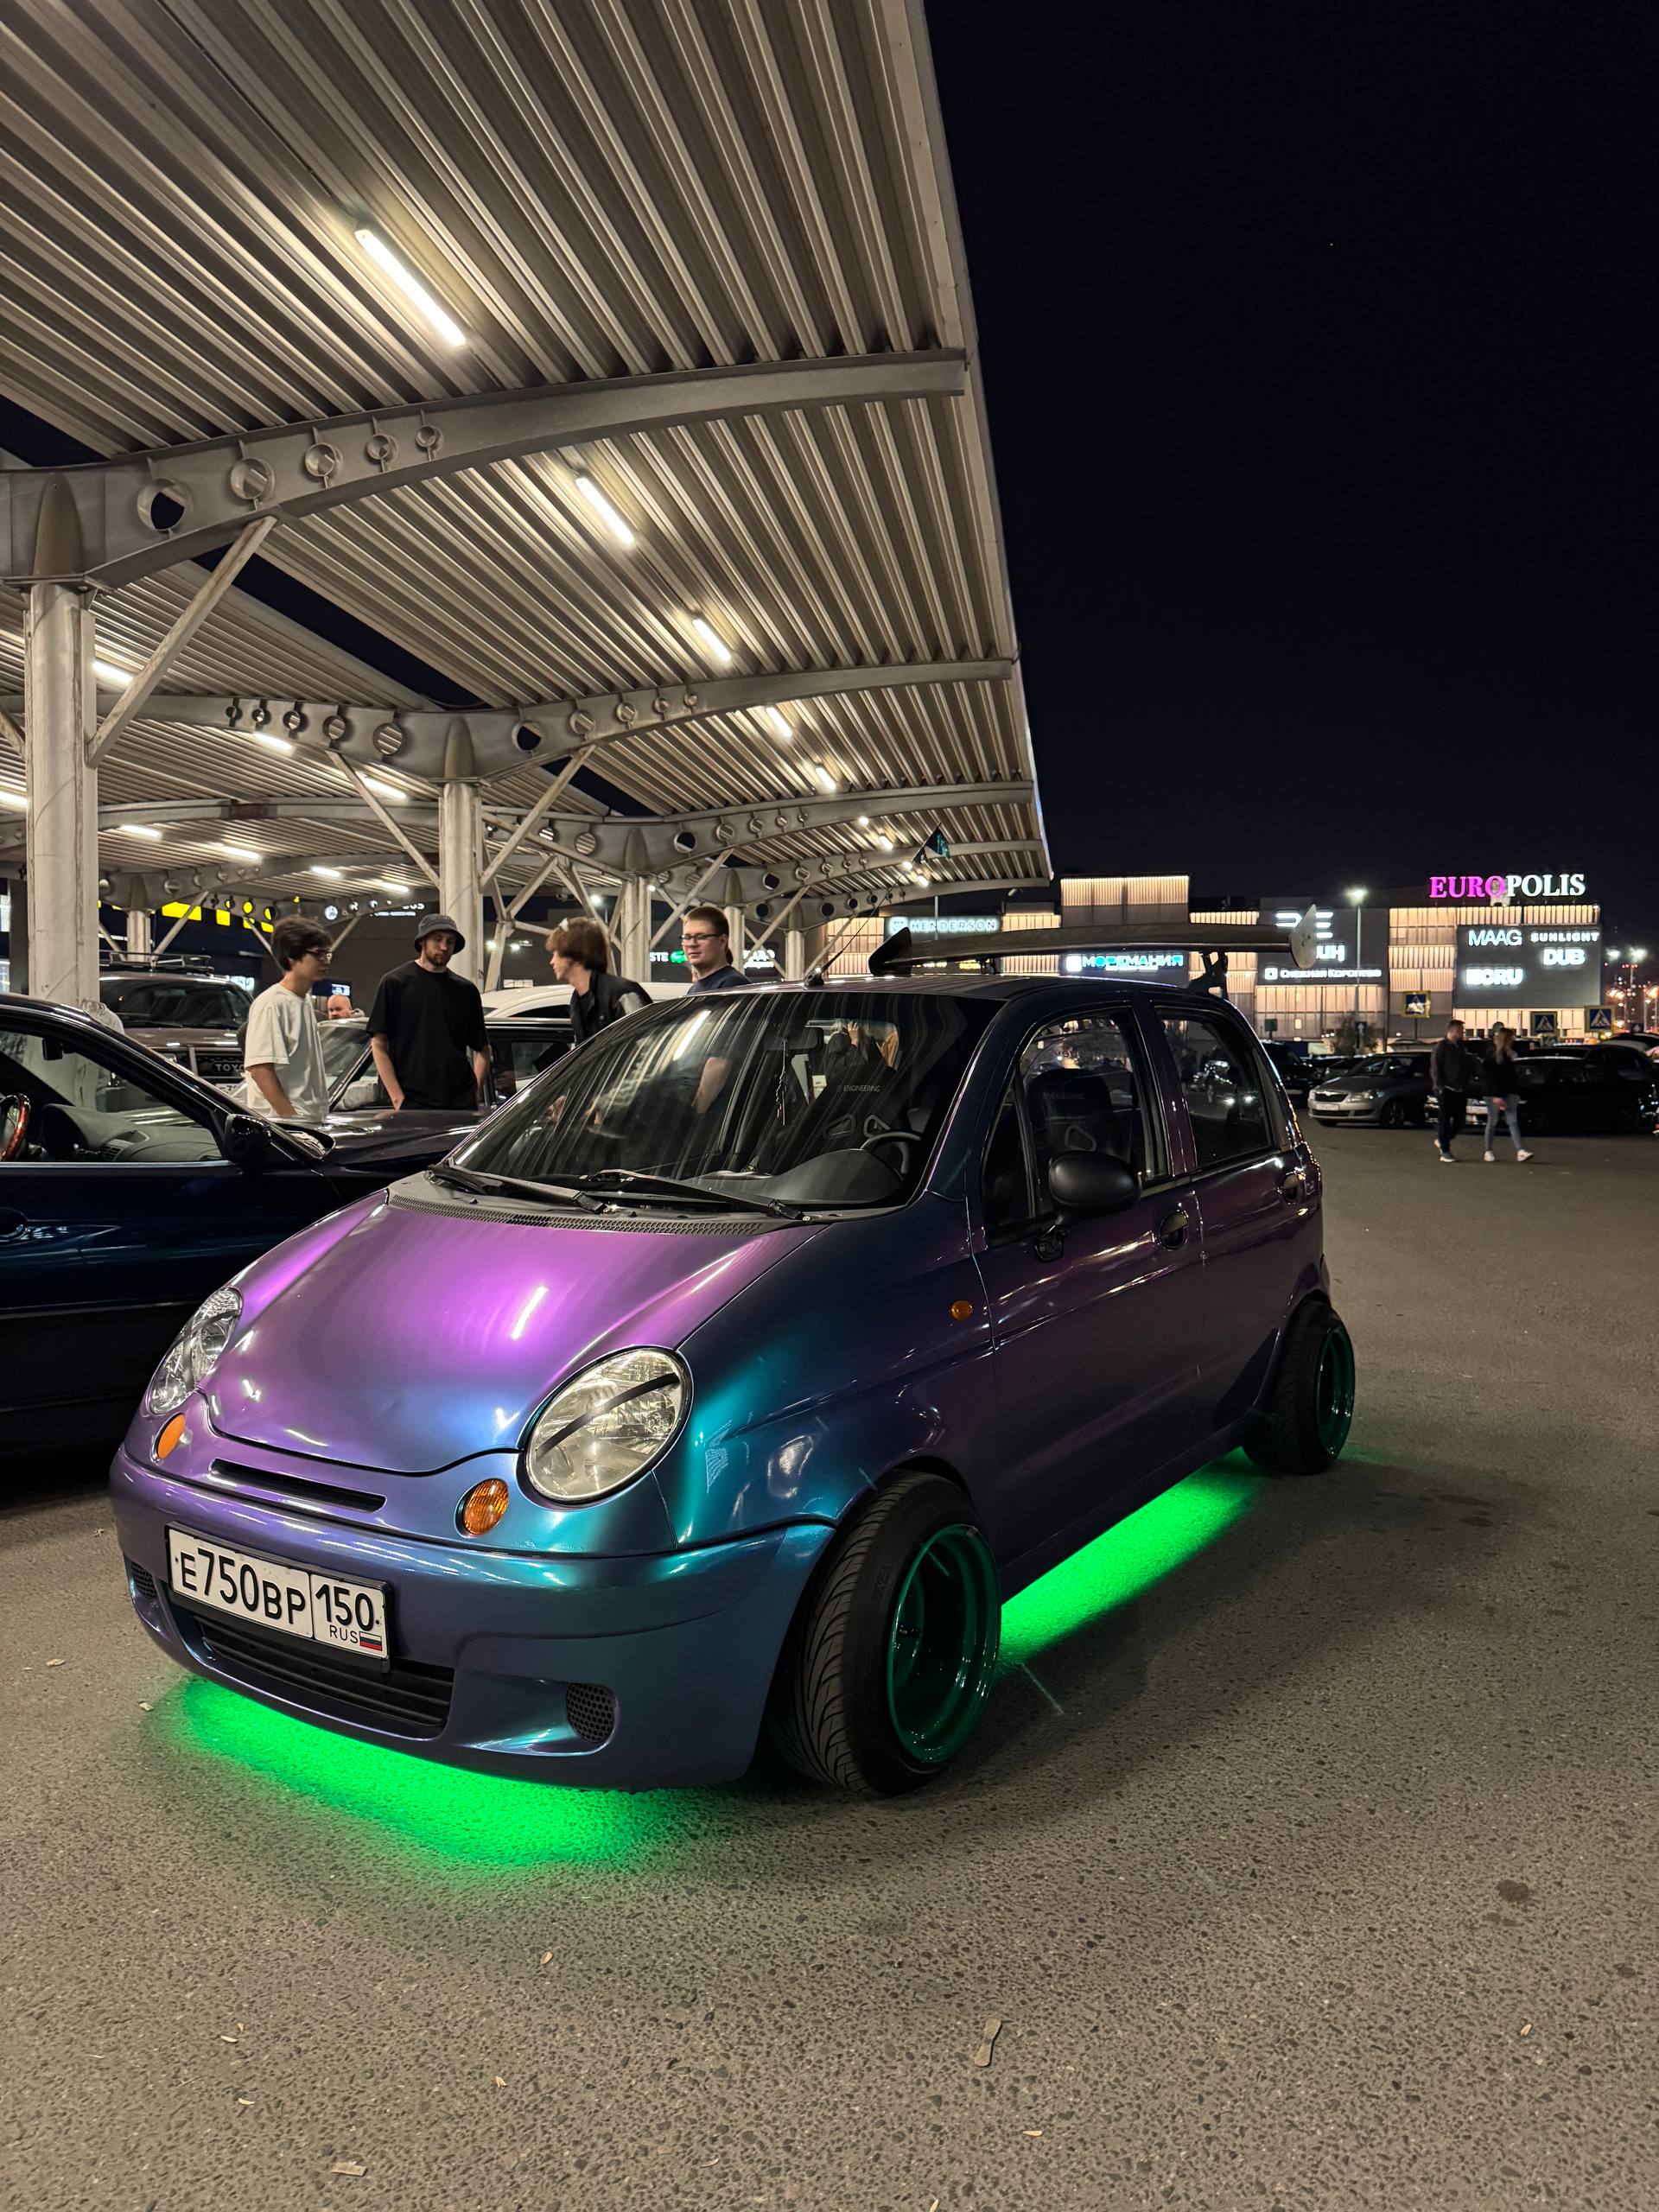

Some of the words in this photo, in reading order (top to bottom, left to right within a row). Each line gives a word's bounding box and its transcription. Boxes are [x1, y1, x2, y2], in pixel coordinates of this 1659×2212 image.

[1429, 874, 1586, 898] EUROPOLIS
[910, 919, 996, 931] HENDERSON
[1468, 930, 1522, 946] MAAG
[1530, 932, 1599, 942] SUNLIGHT
[1543, 949, 1586, 965] DUB
[315, 1584, 374, 1631] 150
[329, 1624, 359, 1643] RUS
